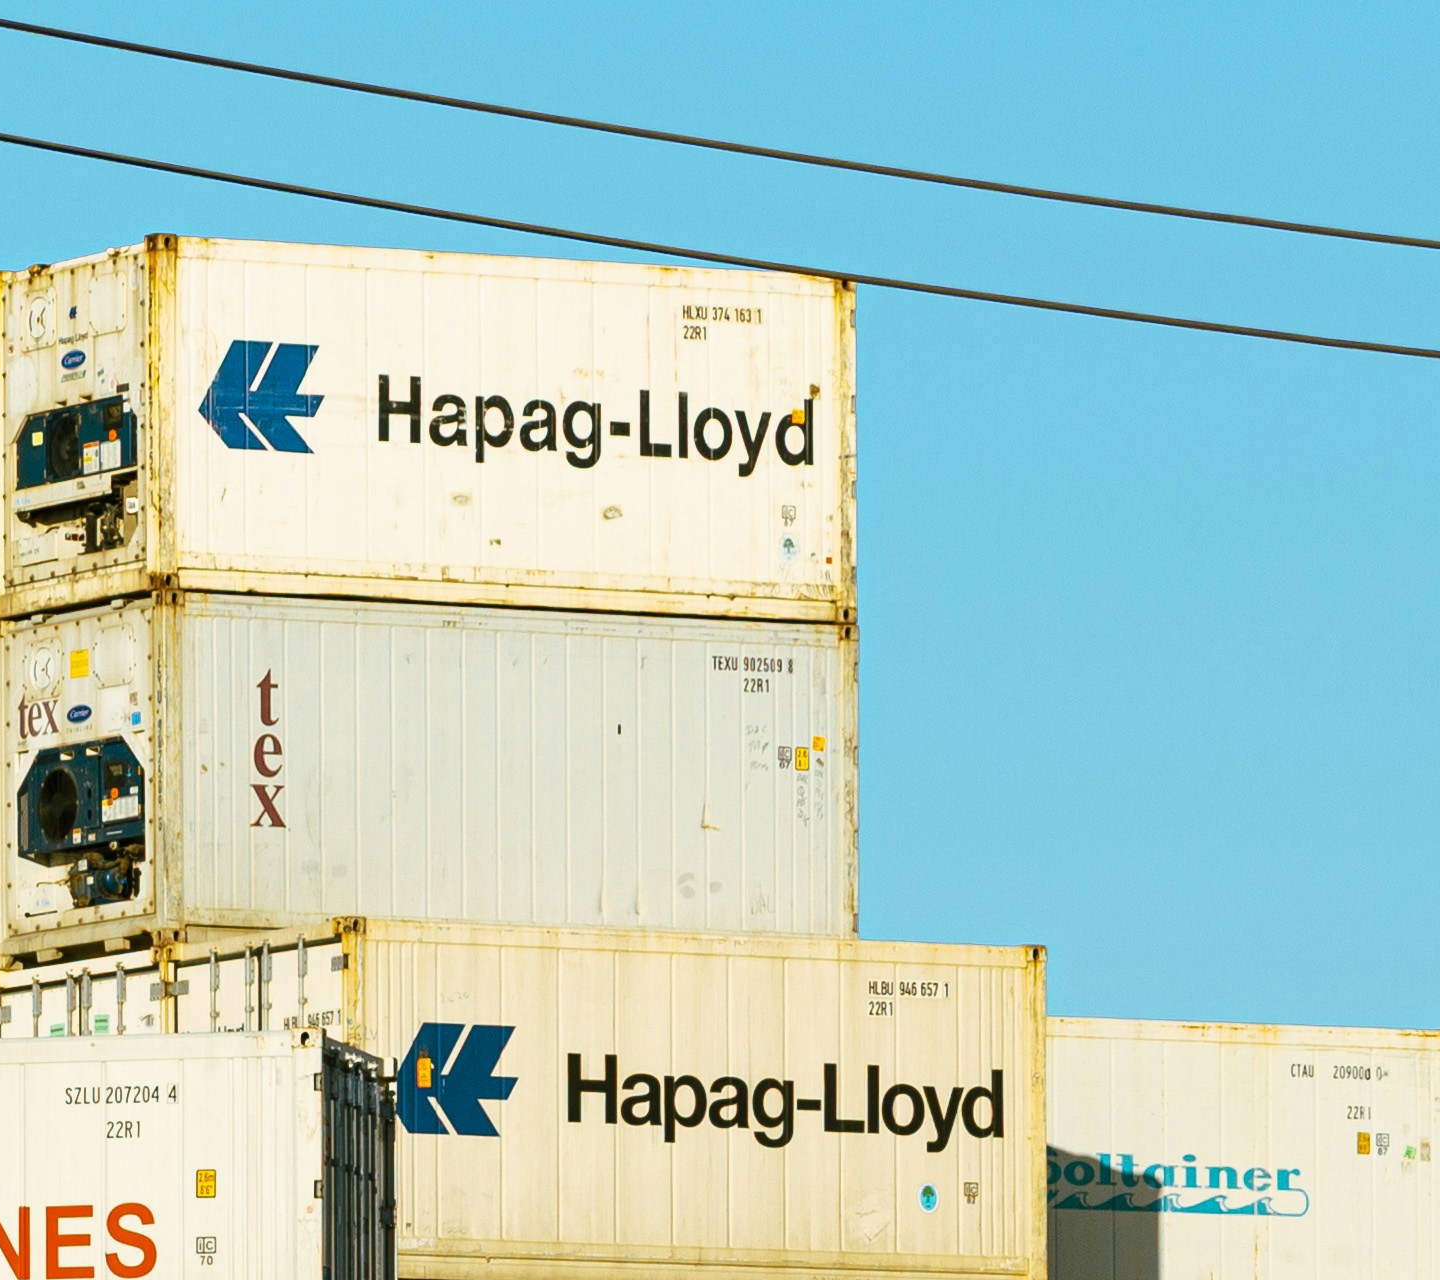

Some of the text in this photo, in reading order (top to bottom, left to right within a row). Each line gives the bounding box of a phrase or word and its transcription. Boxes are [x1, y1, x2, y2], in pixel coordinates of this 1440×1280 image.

[683, 306, 762, 324] HLXU 374 163 1
[683, 326, 707, 340] 22R1
[378, 375, 814, 478] Hapag-Lloyd
[712, 655, 794, 674] TEXU 902509 8
[743, 678, 771, 694] 22R1
[18, 699, 59, 739] tex
[251, 668, 287, 829] tex
[868, 980, 949, 998] HLBU 946 657 1
[868, 1002, 894, 1016] 22R1
[64, 1083, 178, 1106] SZLU 207204 4
[567, 1052, 1005, 1153] Hapag-Lloyd
[106, 1121, 142, 1139] 22R1
